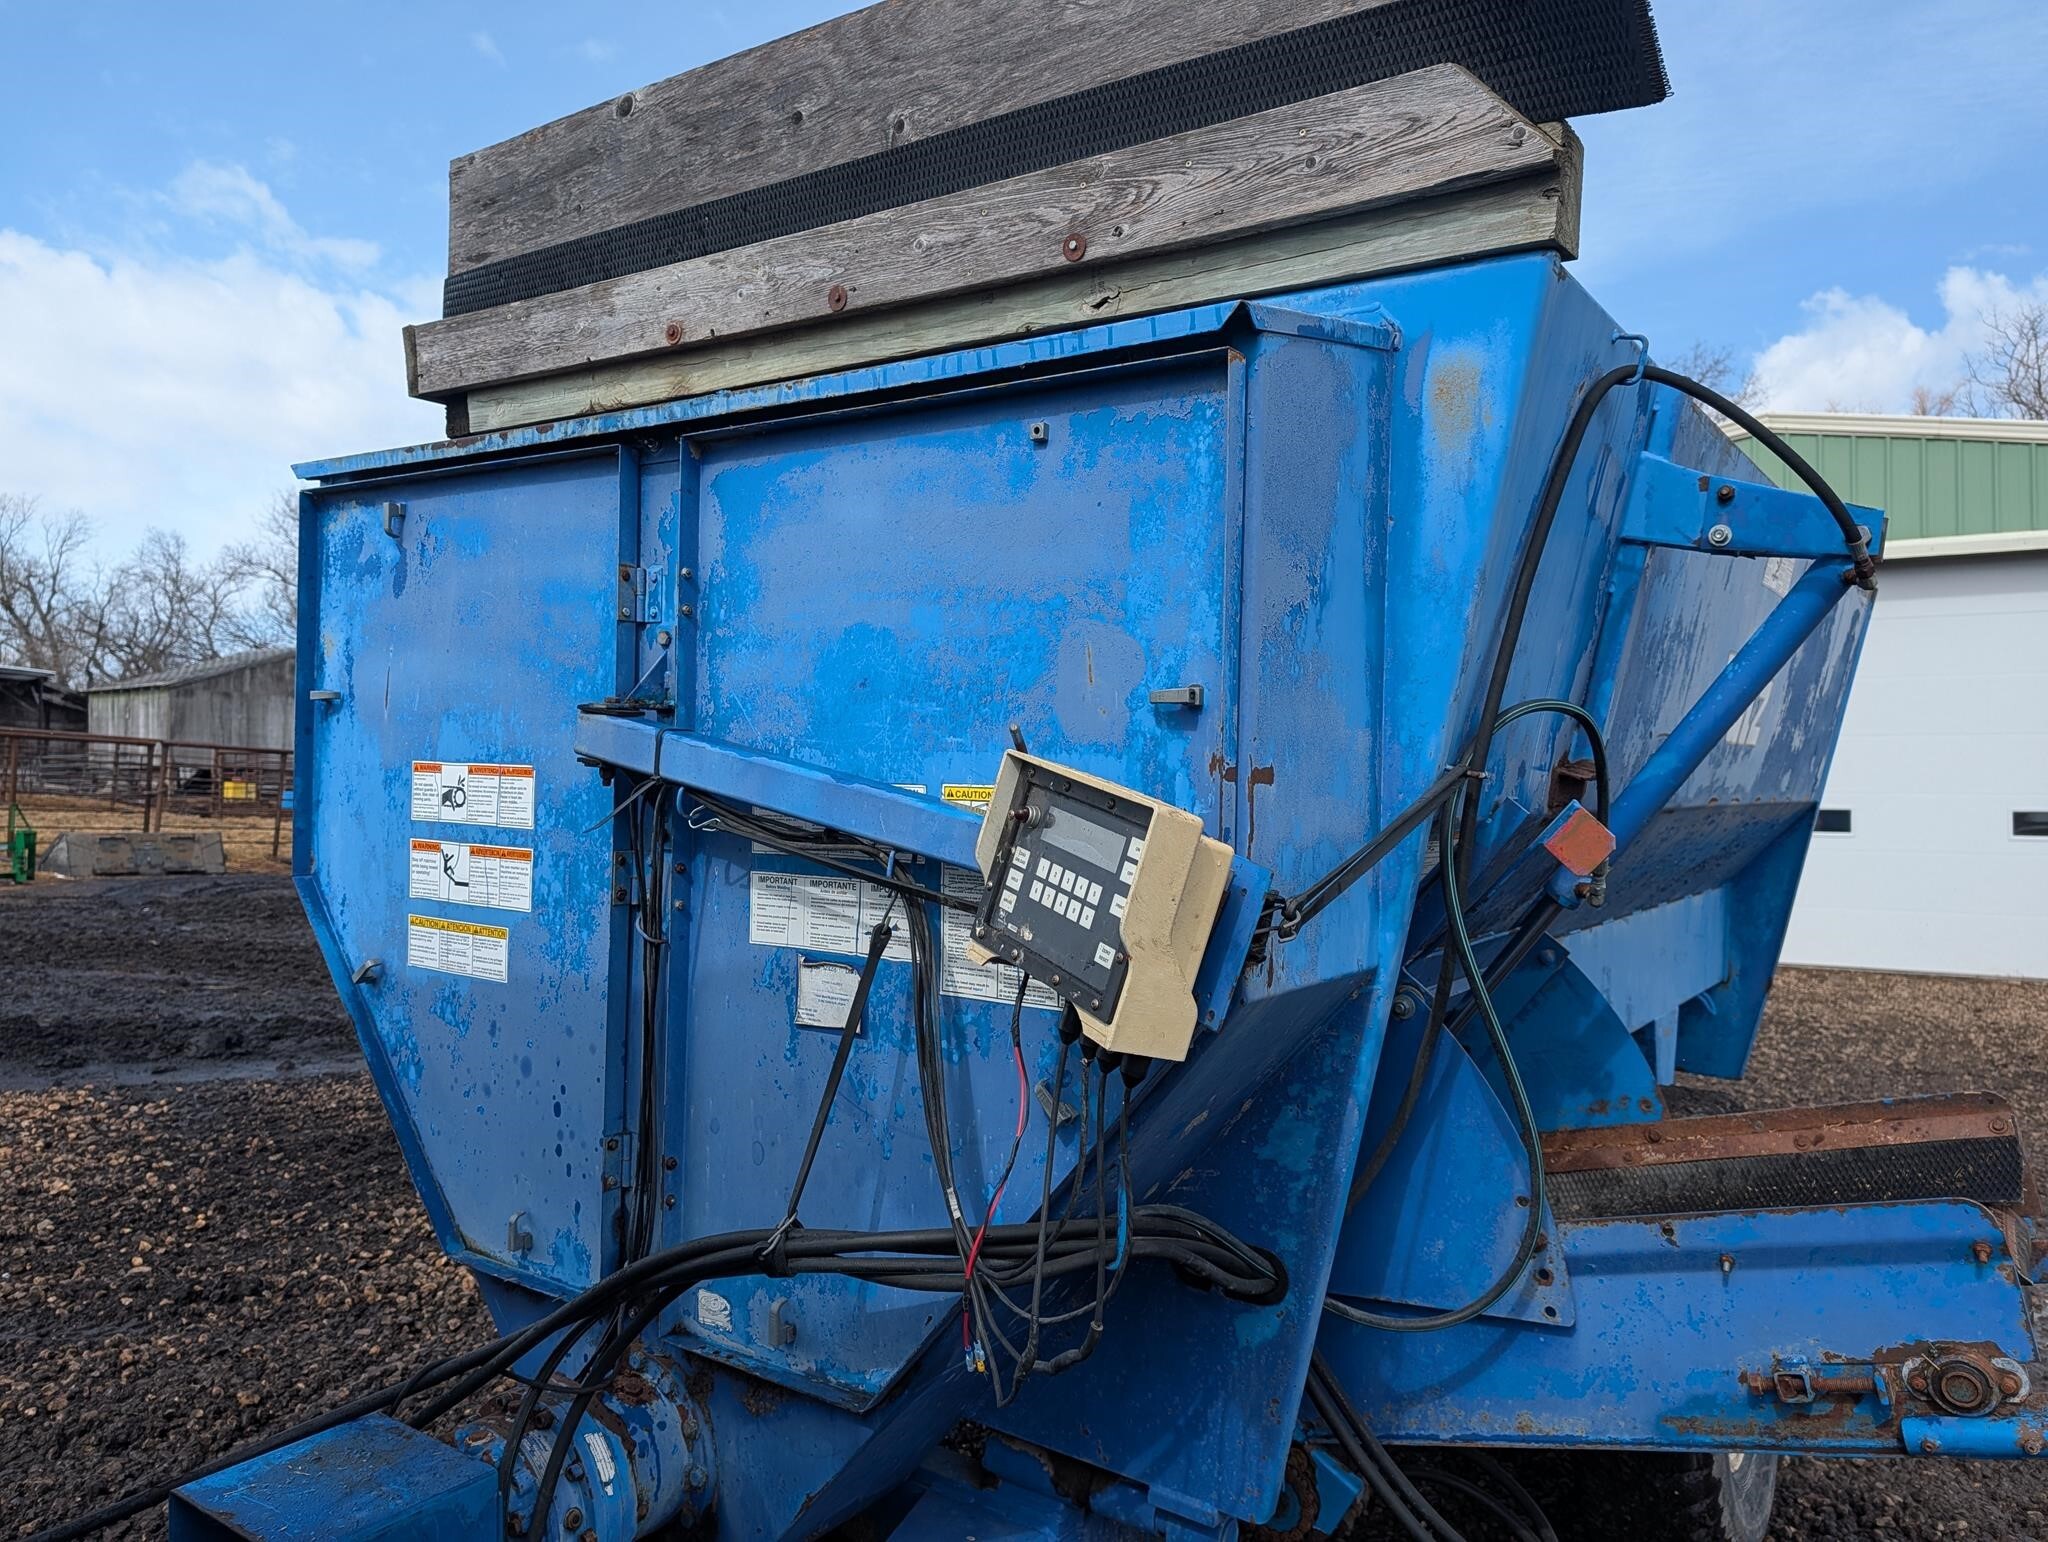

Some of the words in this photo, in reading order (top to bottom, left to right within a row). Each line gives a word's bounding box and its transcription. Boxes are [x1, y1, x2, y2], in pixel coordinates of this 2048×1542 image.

[758, 875, 798, 886] IMPORTANT
[810, 879, 857, 891] IMPORTANTE
[414, 917, 439, 928] CAUTION
[479, 927, 506, 938] ATTENTION
